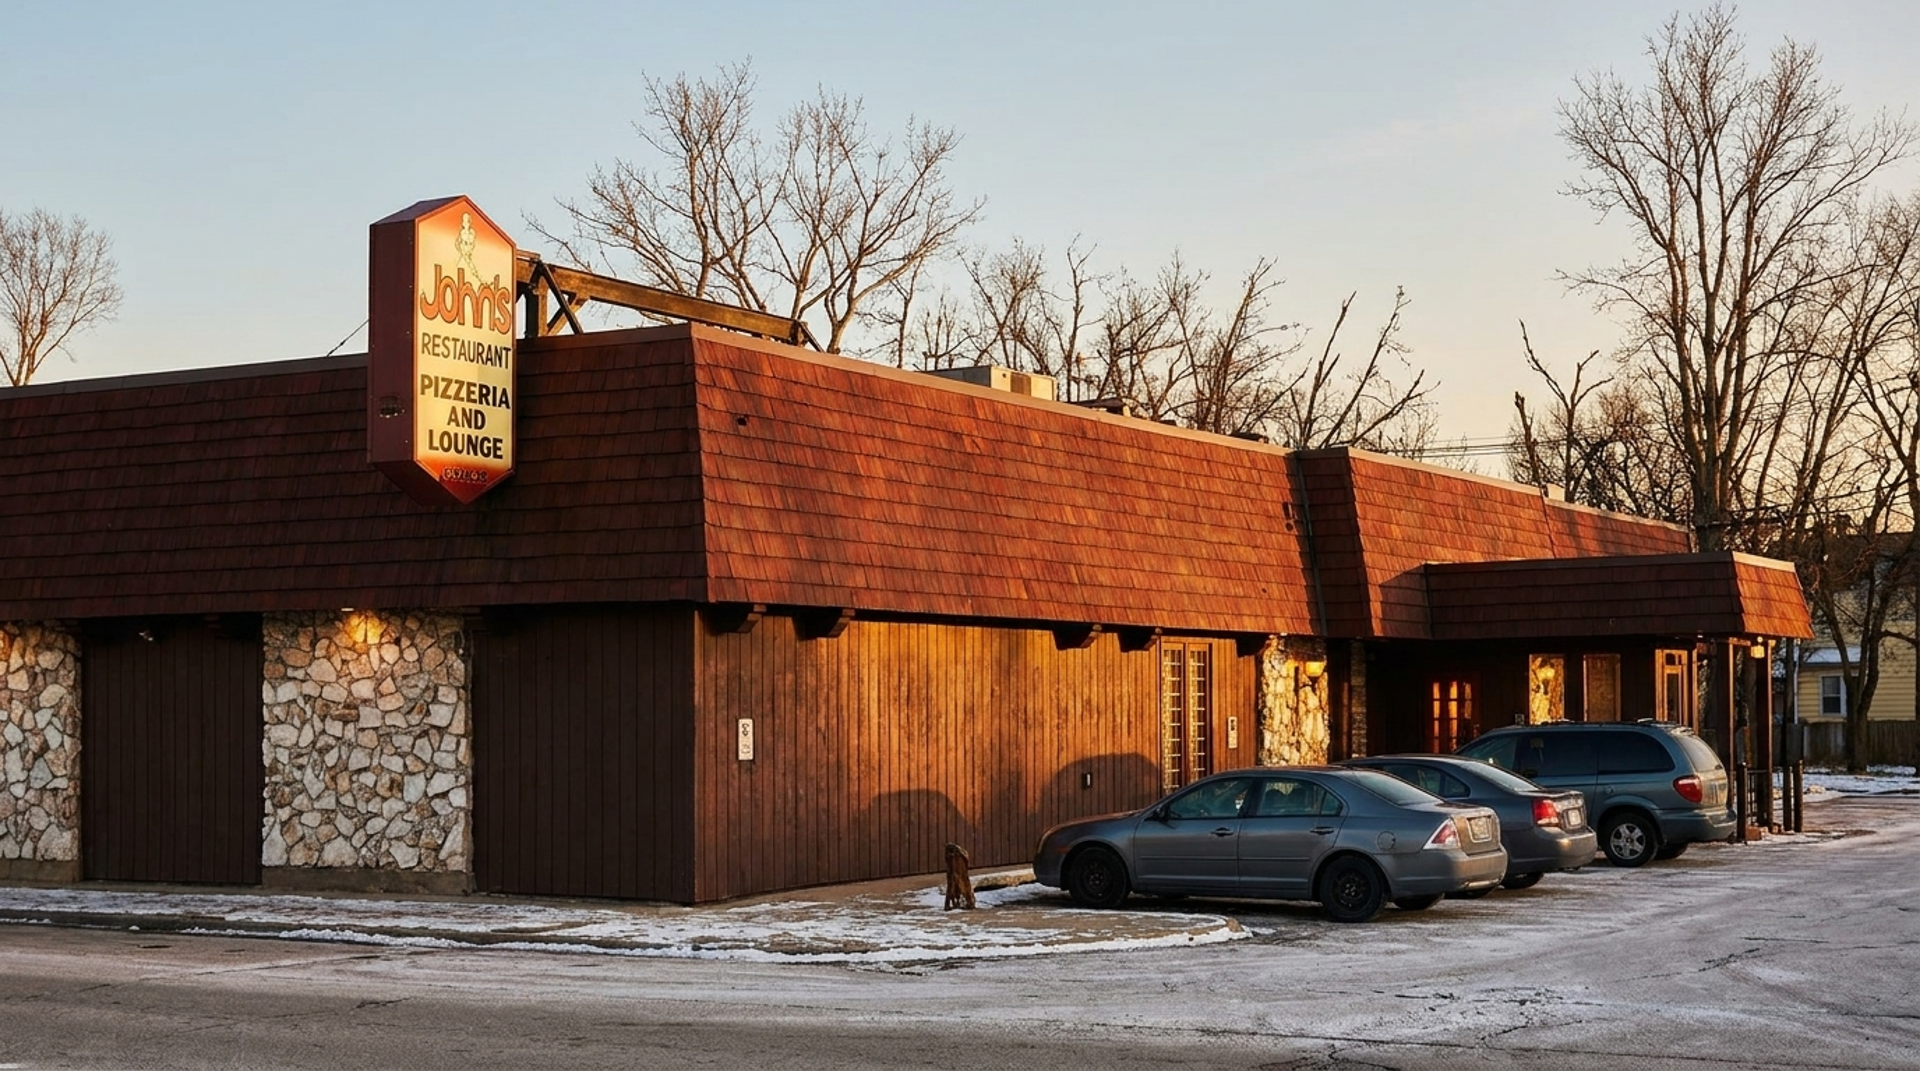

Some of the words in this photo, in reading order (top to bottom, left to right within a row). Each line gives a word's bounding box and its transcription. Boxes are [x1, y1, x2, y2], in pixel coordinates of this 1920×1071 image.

[420, 263, 511, 335] John's
[421, 332, 511, 369] RESTAURANT
[420, 374, 510, 409] PIZZERIA
[447, 405, 486, 430] AND
[428, 429, 503, 460] LOUNGE
